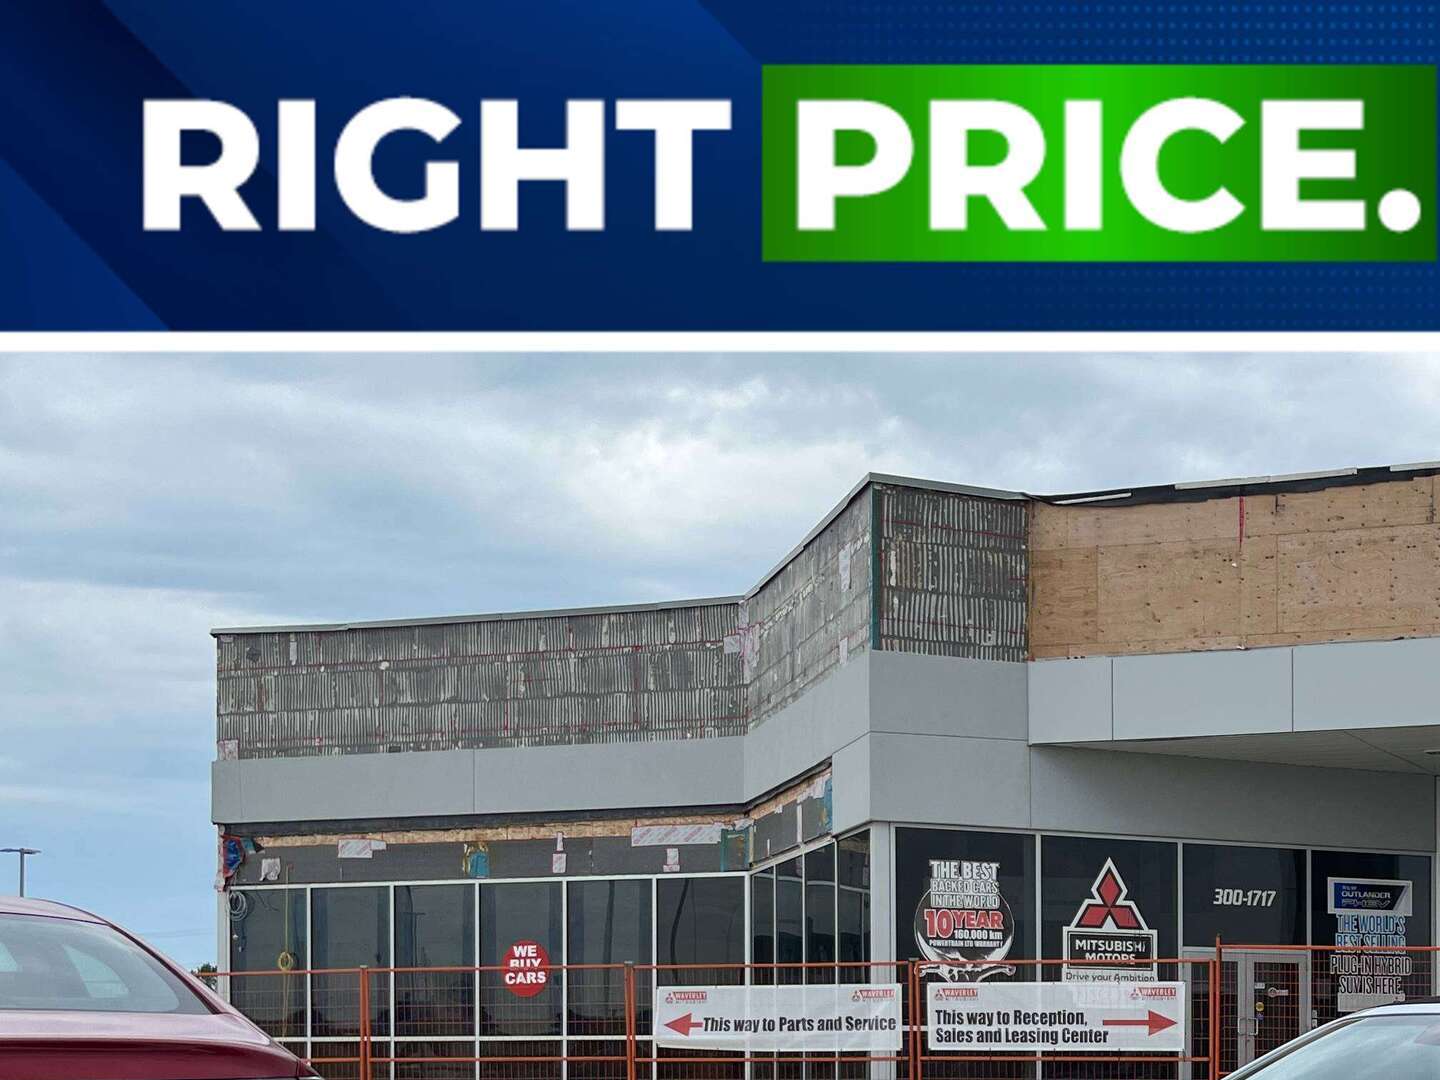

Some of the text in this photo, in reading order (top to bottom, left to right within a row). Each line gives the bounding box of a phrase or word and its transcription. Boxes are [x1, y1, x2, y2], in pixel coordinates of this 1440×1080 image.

[930, 860, 1000, 881] THE BEST
[931, 880, 999, 894] BACKED CARS
[1341, 890, 1391, 899] OUTLANDER
[931, 894, 1000, 909] IN THE WORLD
[1213, 888, 1276, 907] 300-1717
[924, 909, 1004, 938] 10 YEAR
[1336, 914, 1406, 934] THE WORLD'S
[513, 945, 537, 957] WE
[1075, 939, 1146, 953] MITSUBISHI
[1335, 934, 1362, 953] BEST
[1374, 956, 1413, 976] HYBRID
[505, 971, 546, 985] CARS
[1066, 972, 1155, 982] Drive your Ambition
[1339, 976, 1360, 994] SUV
[703, 1016, 896, 1033] This way to Parts and Service
[935, 1009, 1088, 1027] This way to Reception,
[935, 1028, 1109, 1045] Sales and Leasing Center
